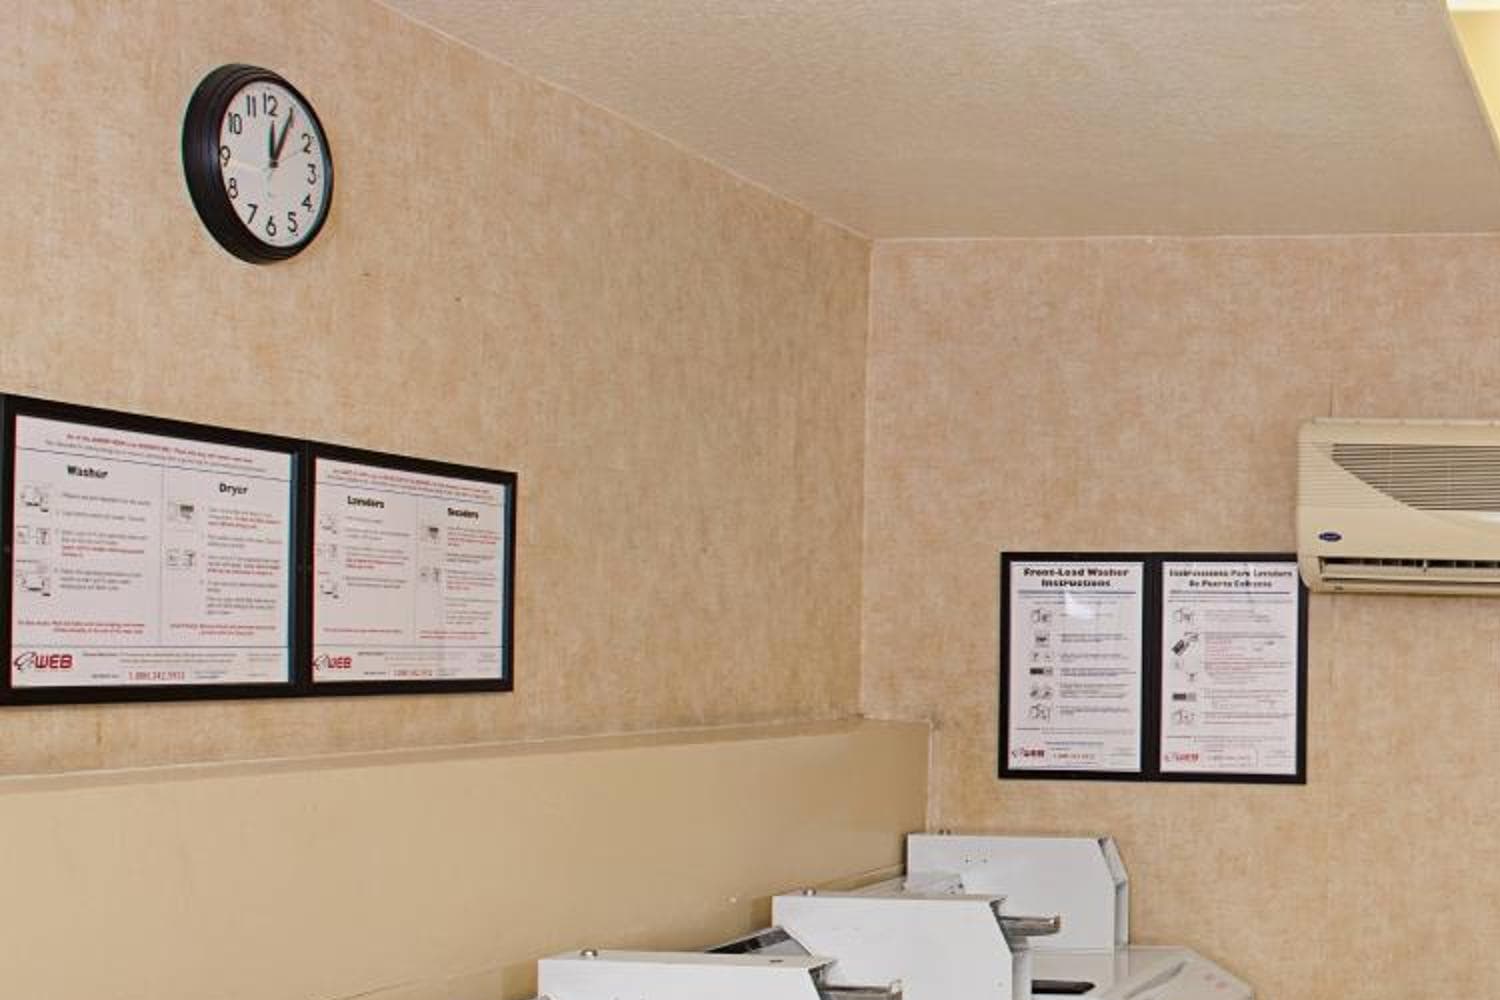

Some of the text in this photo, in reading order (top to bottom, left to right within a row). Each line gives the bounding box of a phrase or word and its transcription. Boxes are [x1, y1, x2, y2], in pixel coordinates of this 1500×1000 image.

[246, 95, 257, 117] 11
[264, 92, 278, 117] 12
[228, 112, 243, 135] 10
[302, 133, 313, 154] 2
[220, 146, 231, 167] 9
[307, 163, 317, 185] 3
[227, 177, 239, 199] 8
[302, 194, 313, 212] 4
[247, 204, 258, 224] 7
[288, 212, 298, 233] 5
[266, 216, 277, 236] 6
[66, 465, 109, 480] Washer
[218, 483, 248, 496] Dryer
